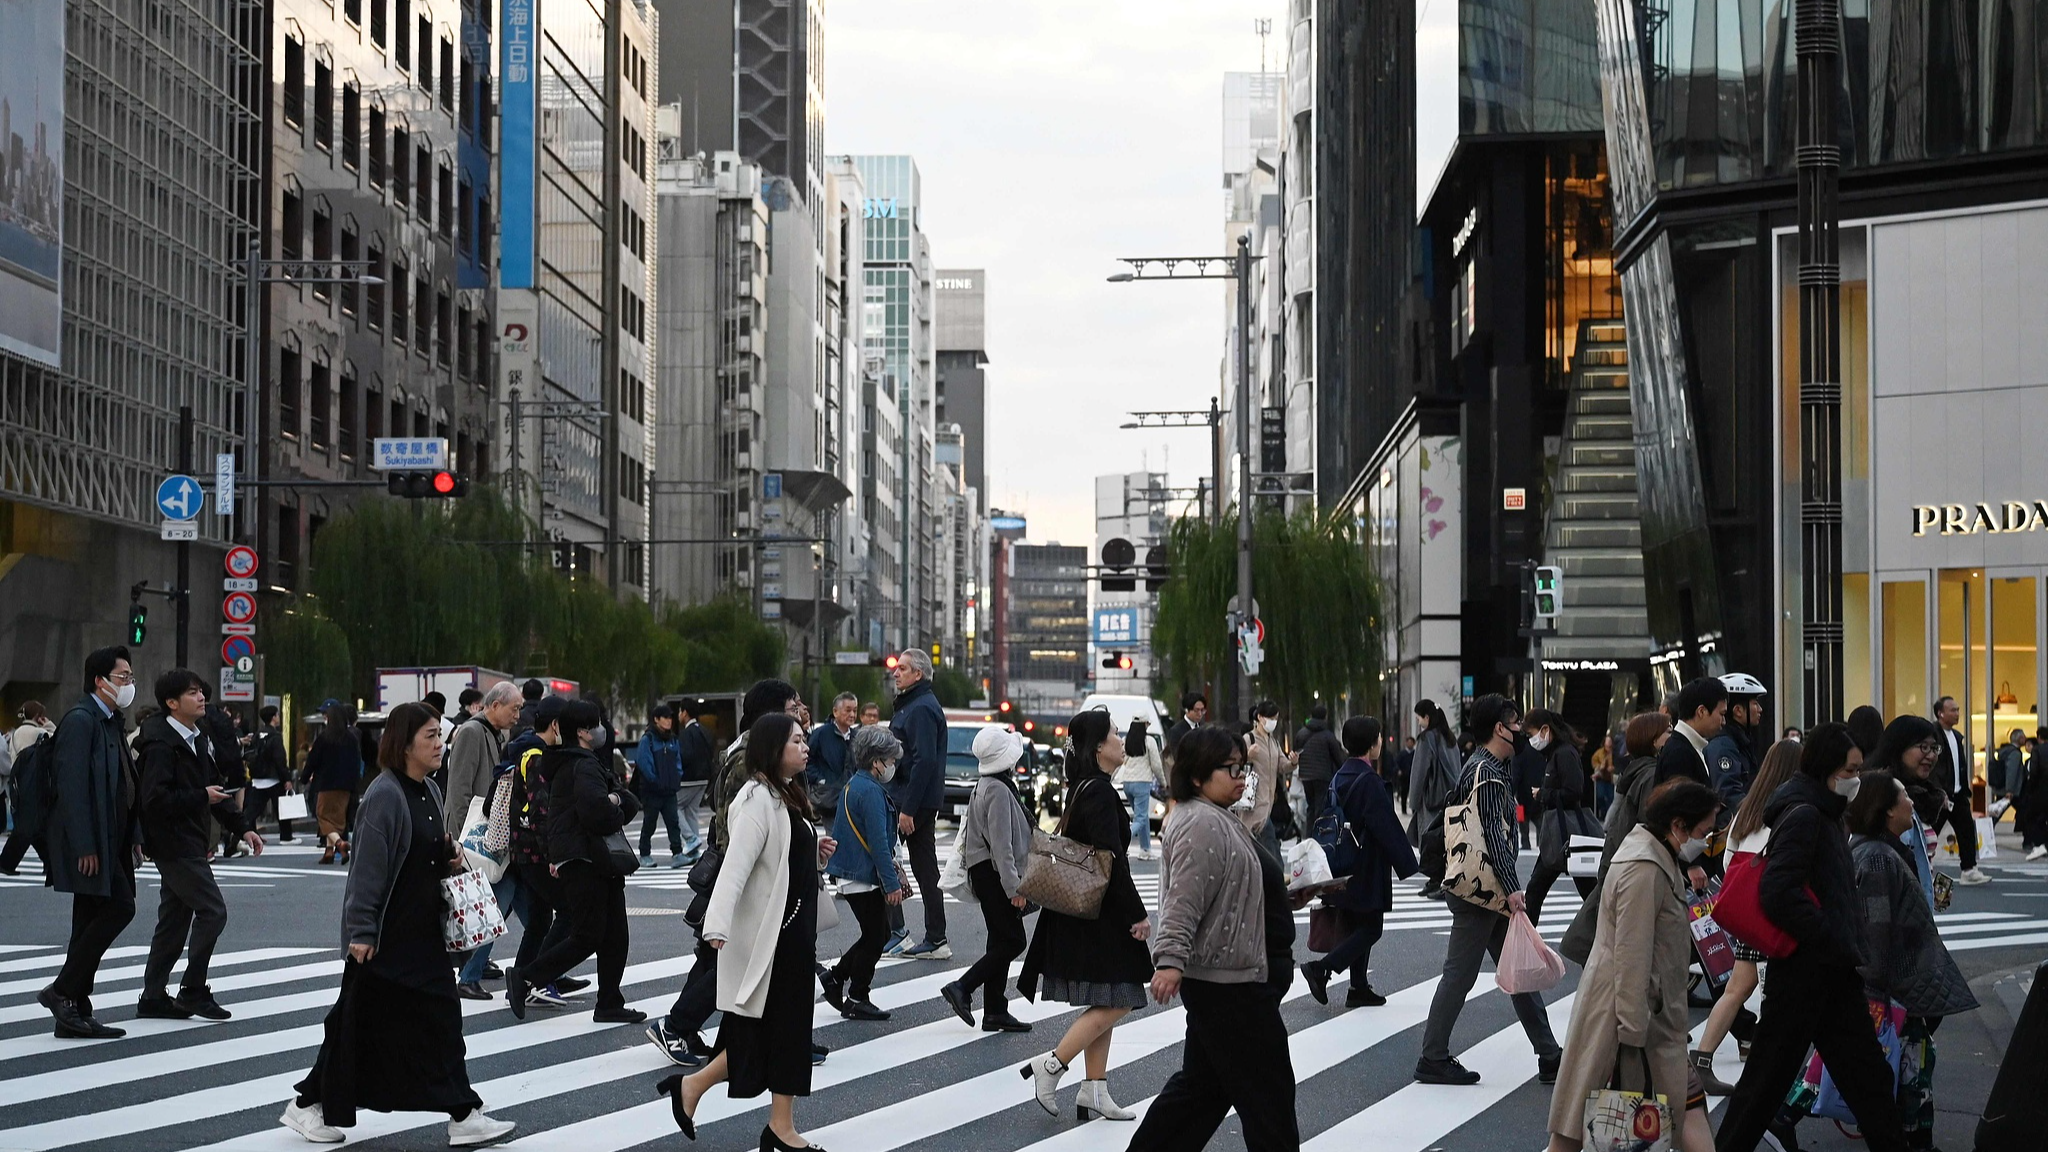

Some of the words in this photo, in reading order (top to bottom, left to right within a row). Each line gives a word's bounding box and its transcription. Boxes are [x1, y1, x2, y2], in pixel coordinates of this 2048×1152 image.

[380, 442, 439, 455] 数寄屋橋
[385, 455, 434, 467] Sukiyabashi
[1912, 499, 2048, 537] PRADA
[1541, 660, 1578, 670] TOKYU
[1580, 660, 1618, 670] PLAZA
